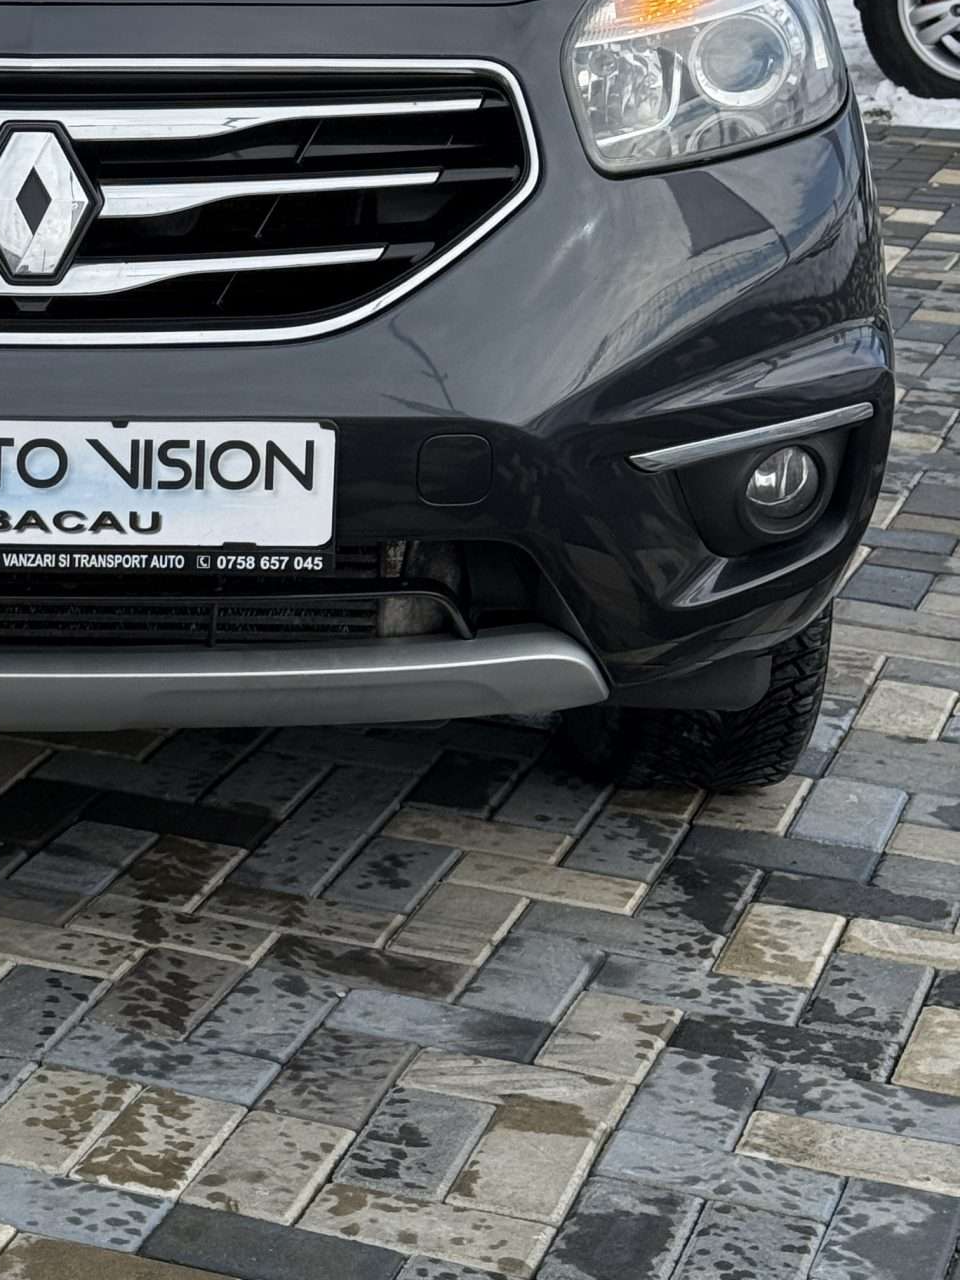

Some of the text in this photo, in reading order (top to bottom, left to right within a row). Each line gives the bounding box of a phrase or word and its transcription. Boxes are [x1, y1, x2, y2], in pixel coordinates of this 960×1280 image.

[85, 438, 315, 491] VISION
[3, 553, 55, 567] VANZARI
[58, 554, 70, 567] SI
[73, 554, 147, 568] TRANSPORT
[150, 555, 185, 568] AUTO
[216, 556, 255, 569] 0758
[260, 556, 289, 569] 657
[294, 556, 324, 570] 045
